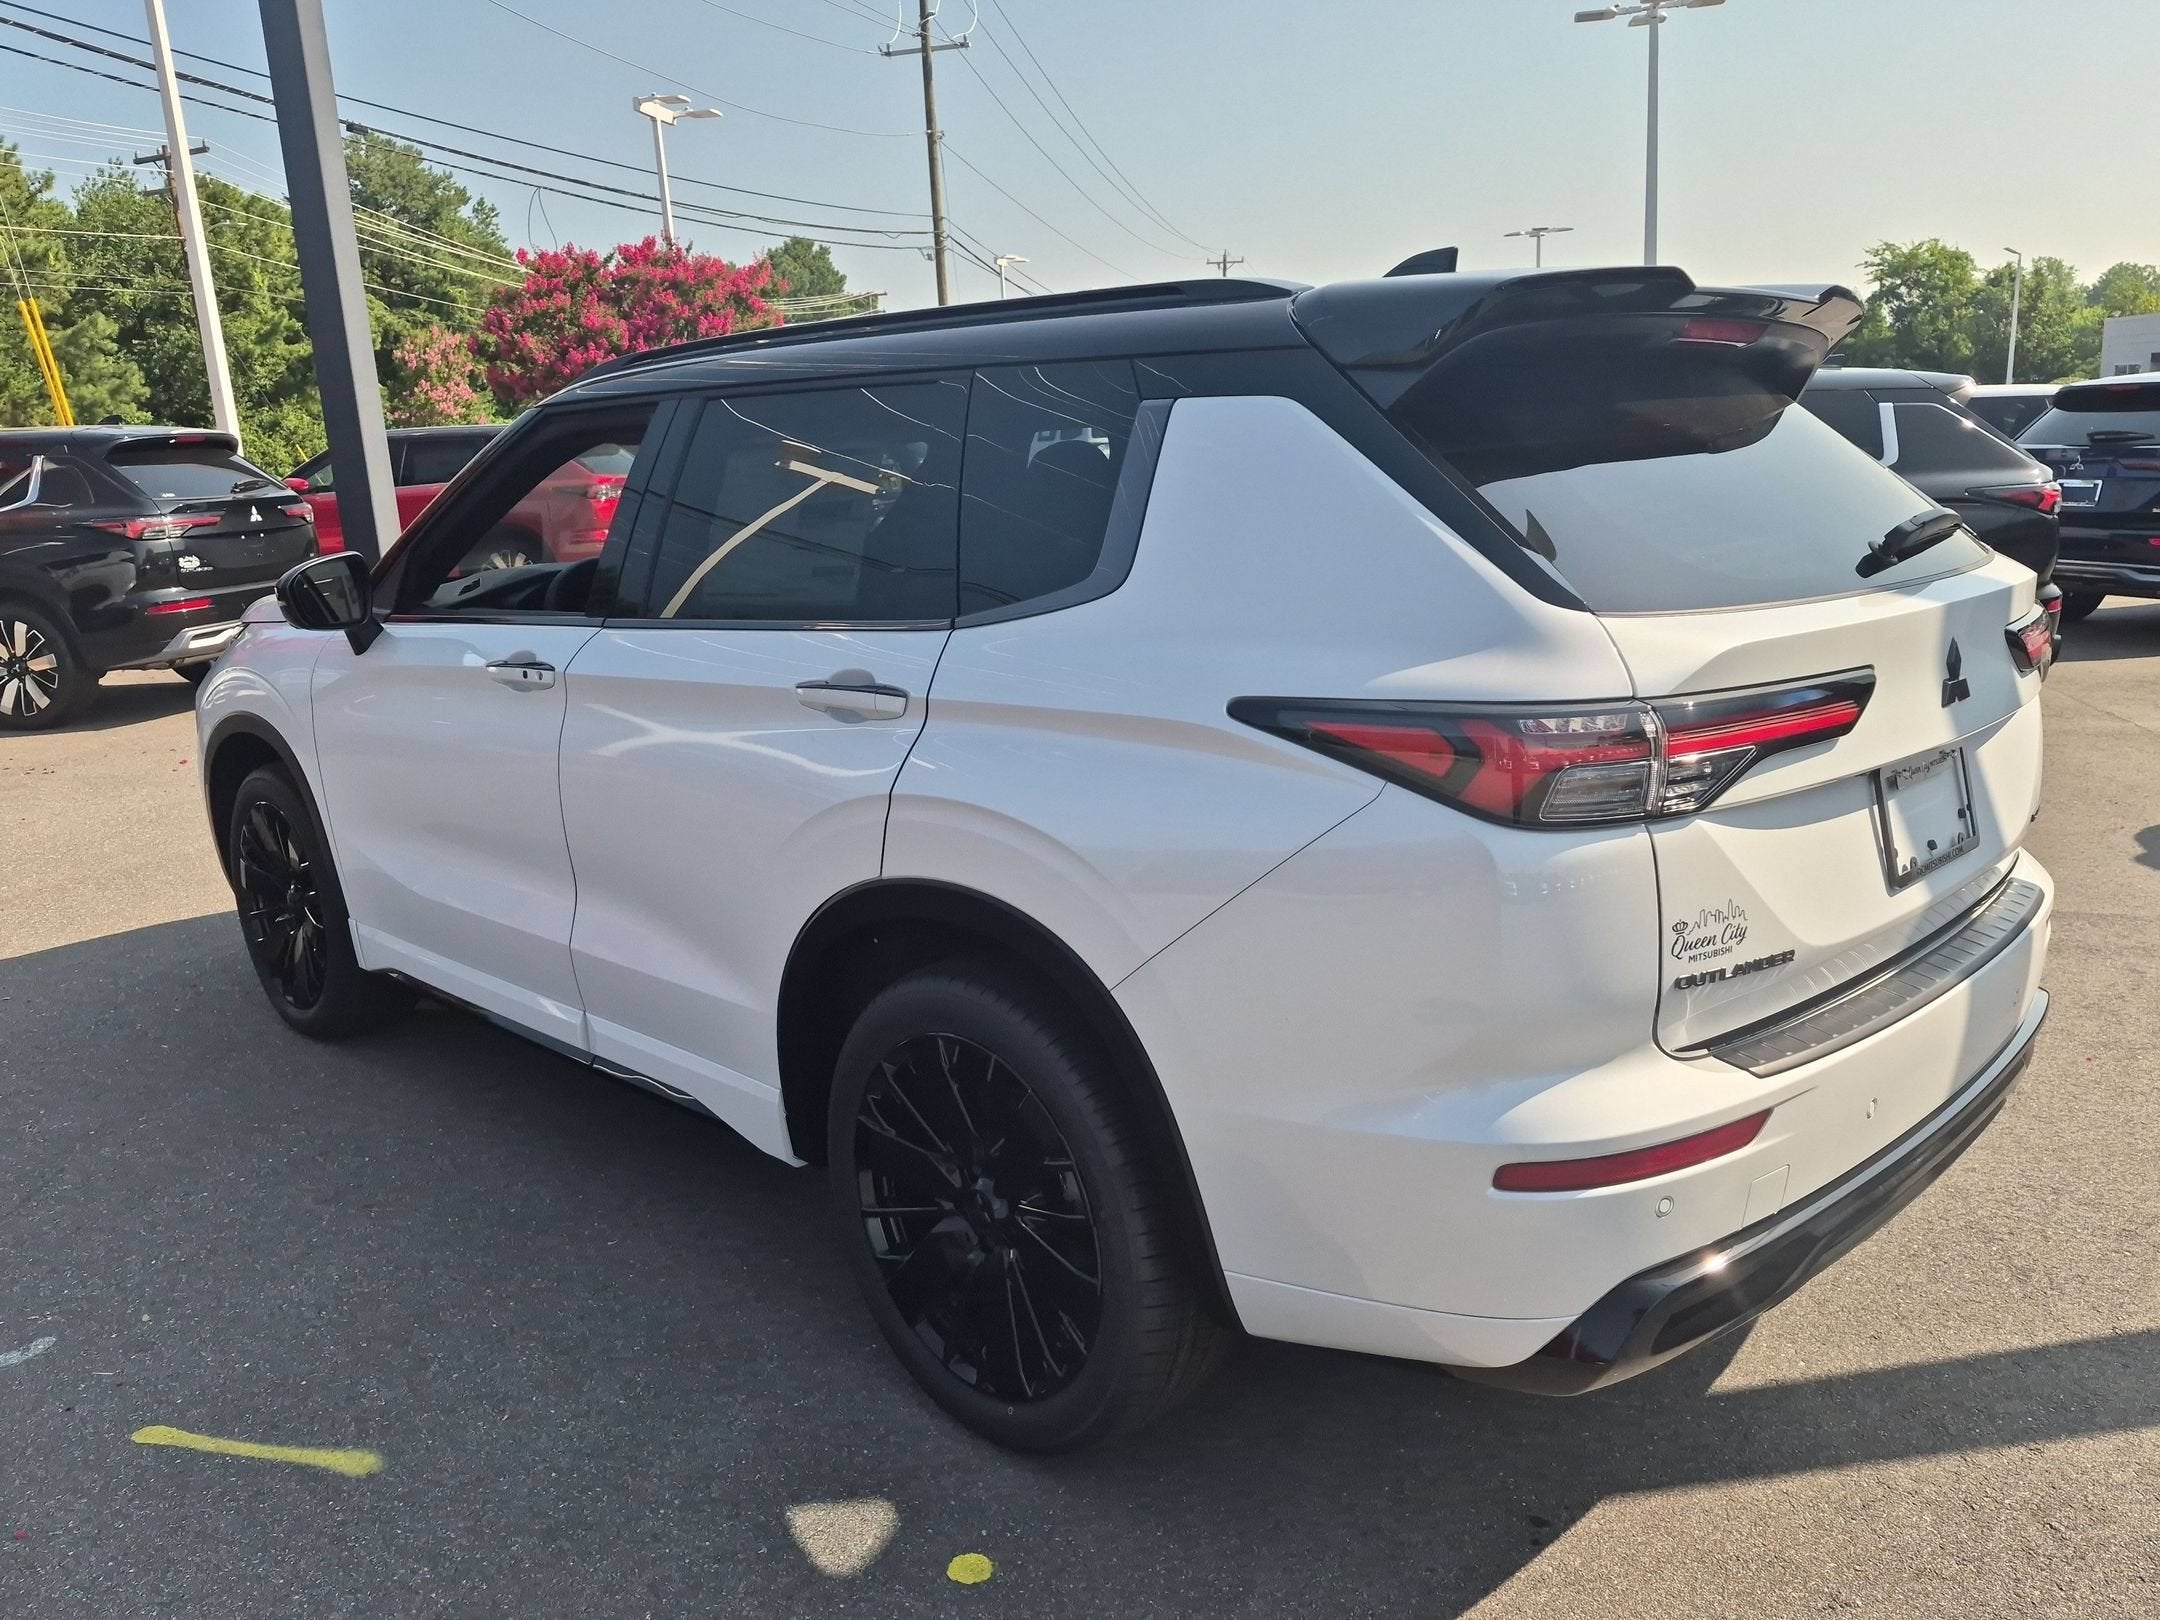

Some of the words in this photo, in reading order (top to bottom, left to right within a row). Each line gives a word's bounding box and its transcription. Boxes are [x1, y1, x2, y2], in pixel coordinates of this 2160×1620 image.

[1671, 934, 1717, 960] Queen
[1721, 923, 1748, 946] City
[1688, 945, 1733, 964] MITSUBISHI
[1674, 949, 1796, 990] OUTLANDER
